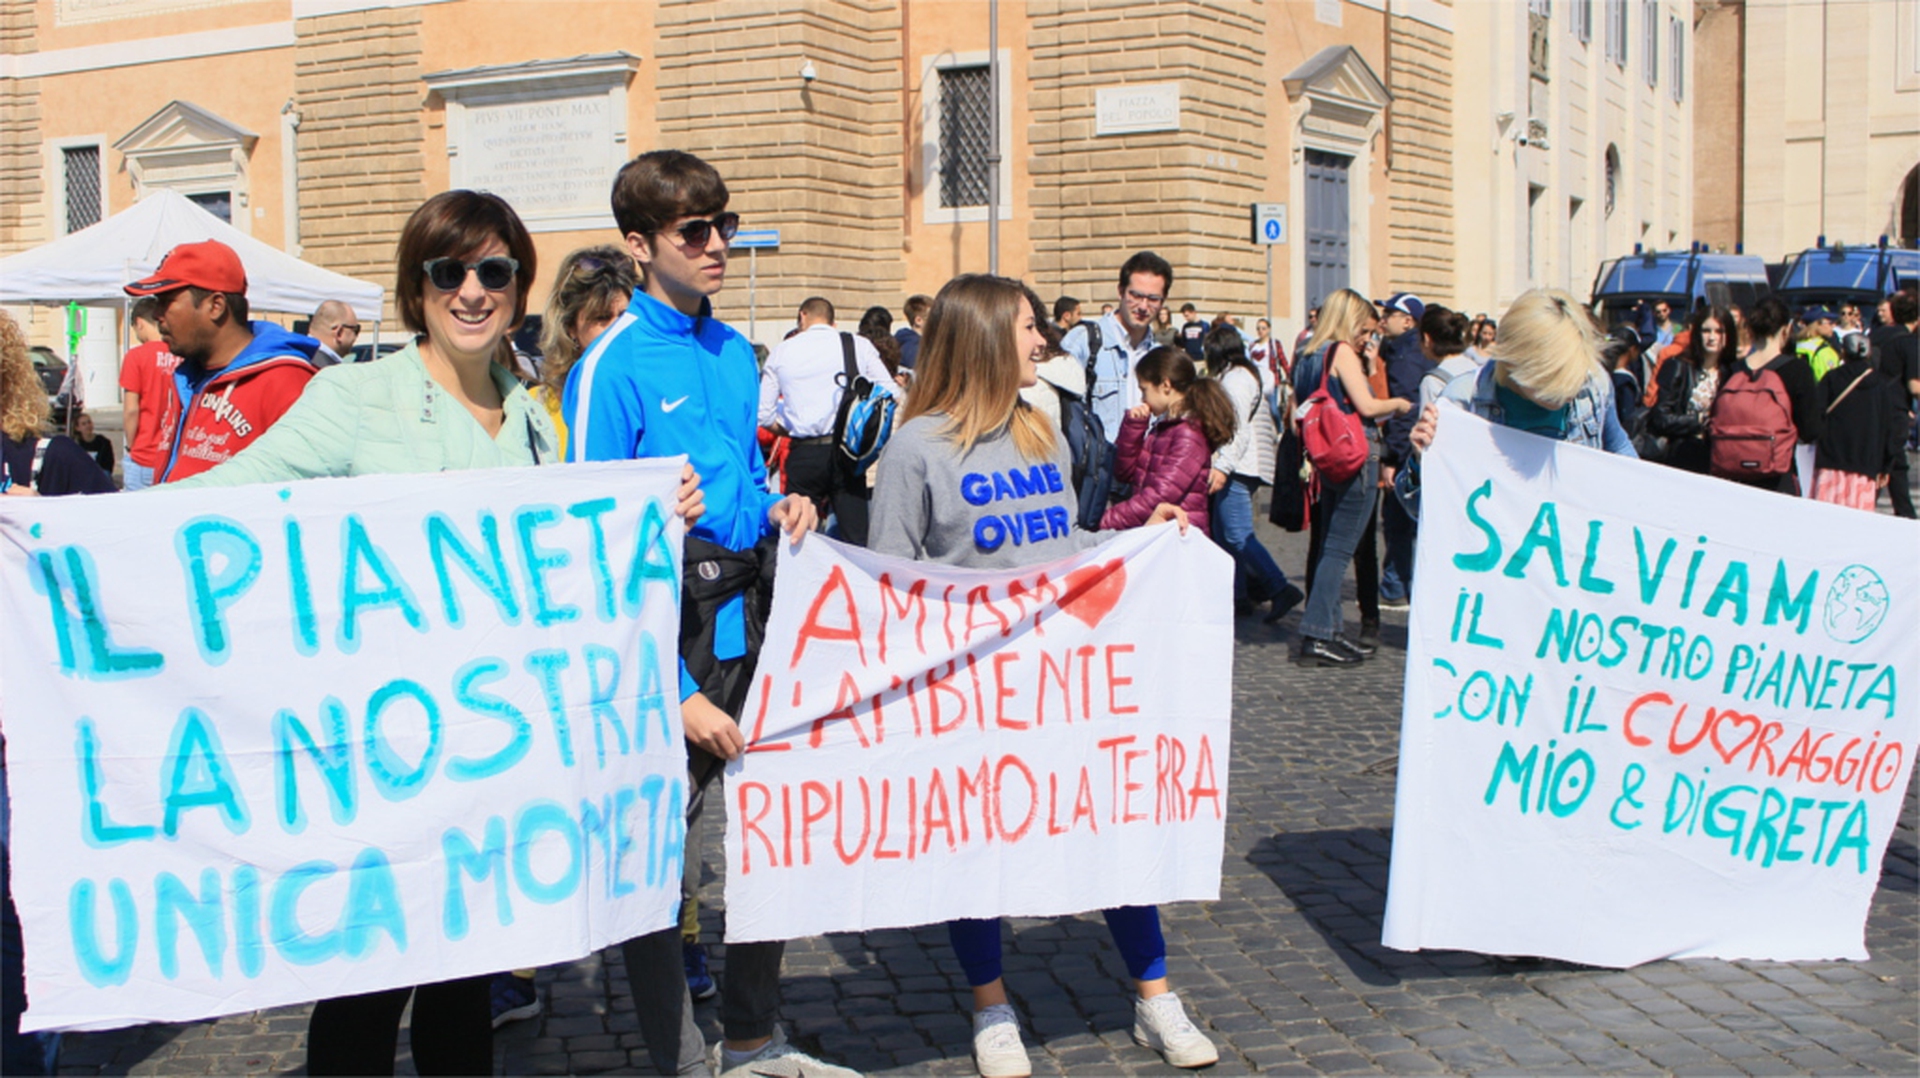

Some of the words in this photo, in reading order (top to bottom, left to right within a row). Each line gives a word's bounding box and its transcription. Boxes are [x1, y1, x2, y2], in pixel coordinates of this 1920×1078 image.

[571, 103, 601, 117] MAX
[1102, 111, 1123, 122] DEL
[1128, 107, 1173, 121] POPOLO
[1119, 96, 1156, 108] PIAZZA
[961, 463, 1064, 507] GAME
[973, 505, 1070, 554] OVER
[790, 565, 1058, 668] AMIAM
[1535, 607, 1715, 681] NOSTRO
[271, 630, 672, 834] NOSTRA
[738, 754, 1038, 874] RIPULIAMO
[1098, 733, 1222, 825] TERRA
[1609, 762, 1647, 831] &
[68, 847, 408, 988] UNICA
[441, 773, 682, 940] MONETA
